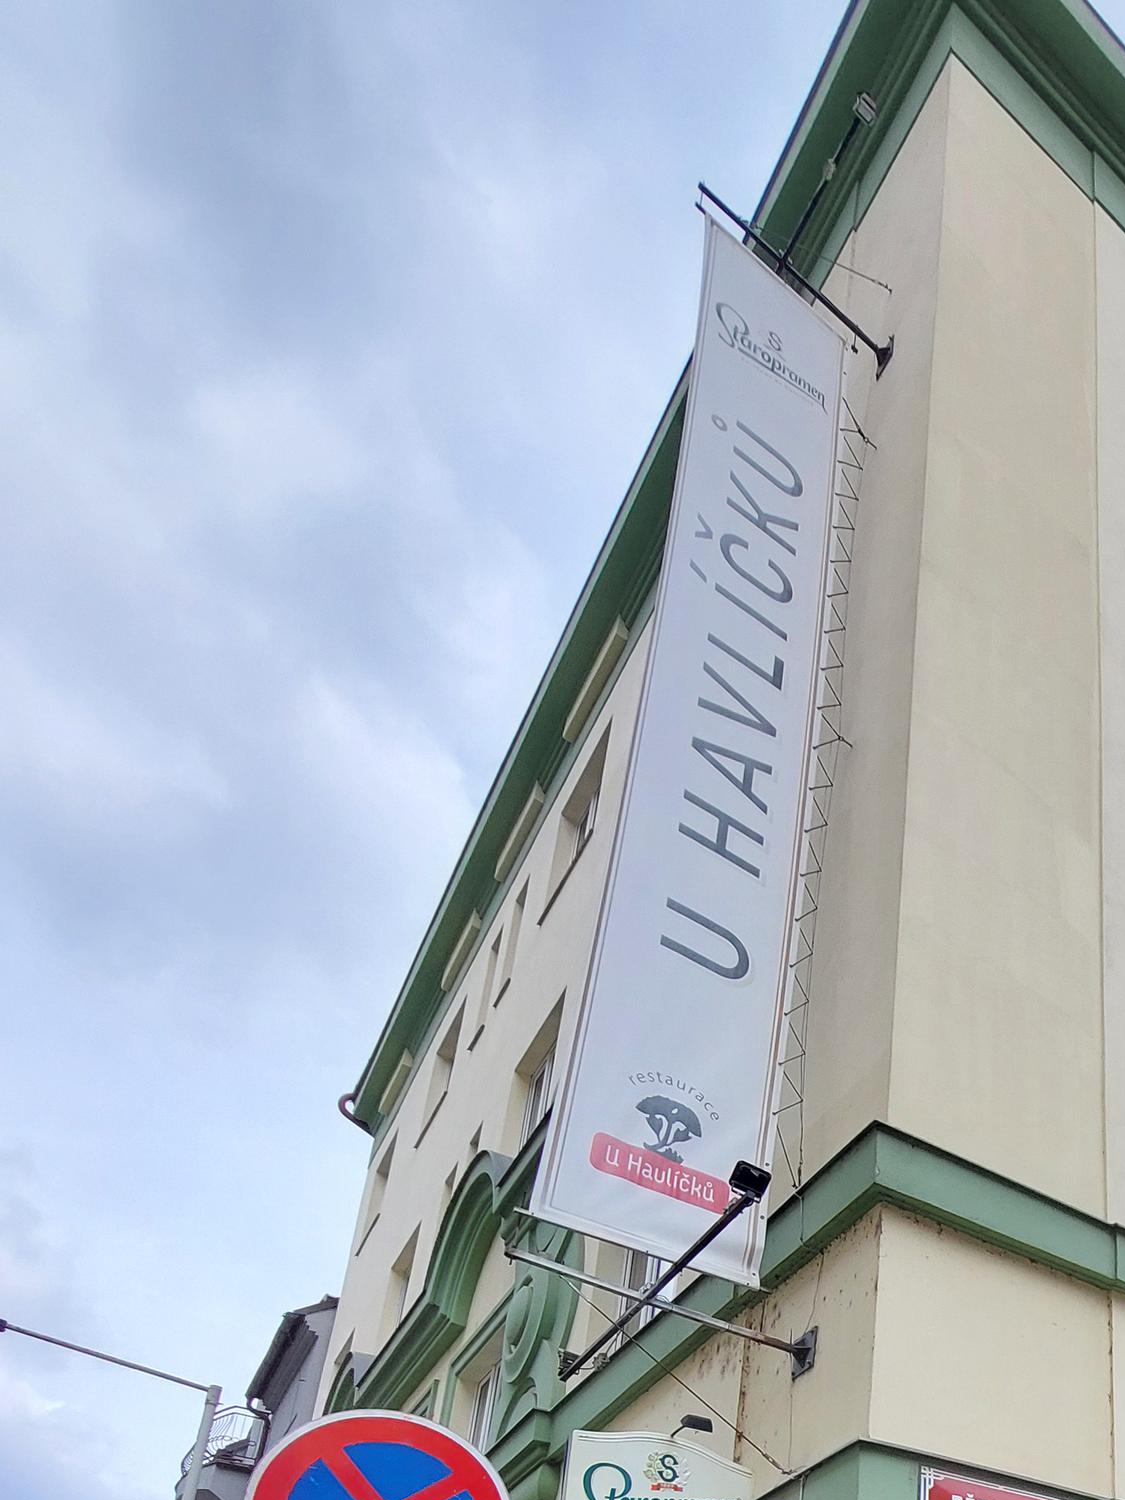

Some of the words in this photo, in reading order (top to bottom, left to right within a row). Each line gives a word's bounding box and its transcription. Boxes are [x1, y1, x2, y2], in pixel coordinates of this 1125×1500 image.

[715, 301, 828, 416] Staropramen
[678, 414, 805, 879] HAVLÍČKŮ
[659, 896, 752, 982] U
[628, 1070, 720, 1123] restaurace
